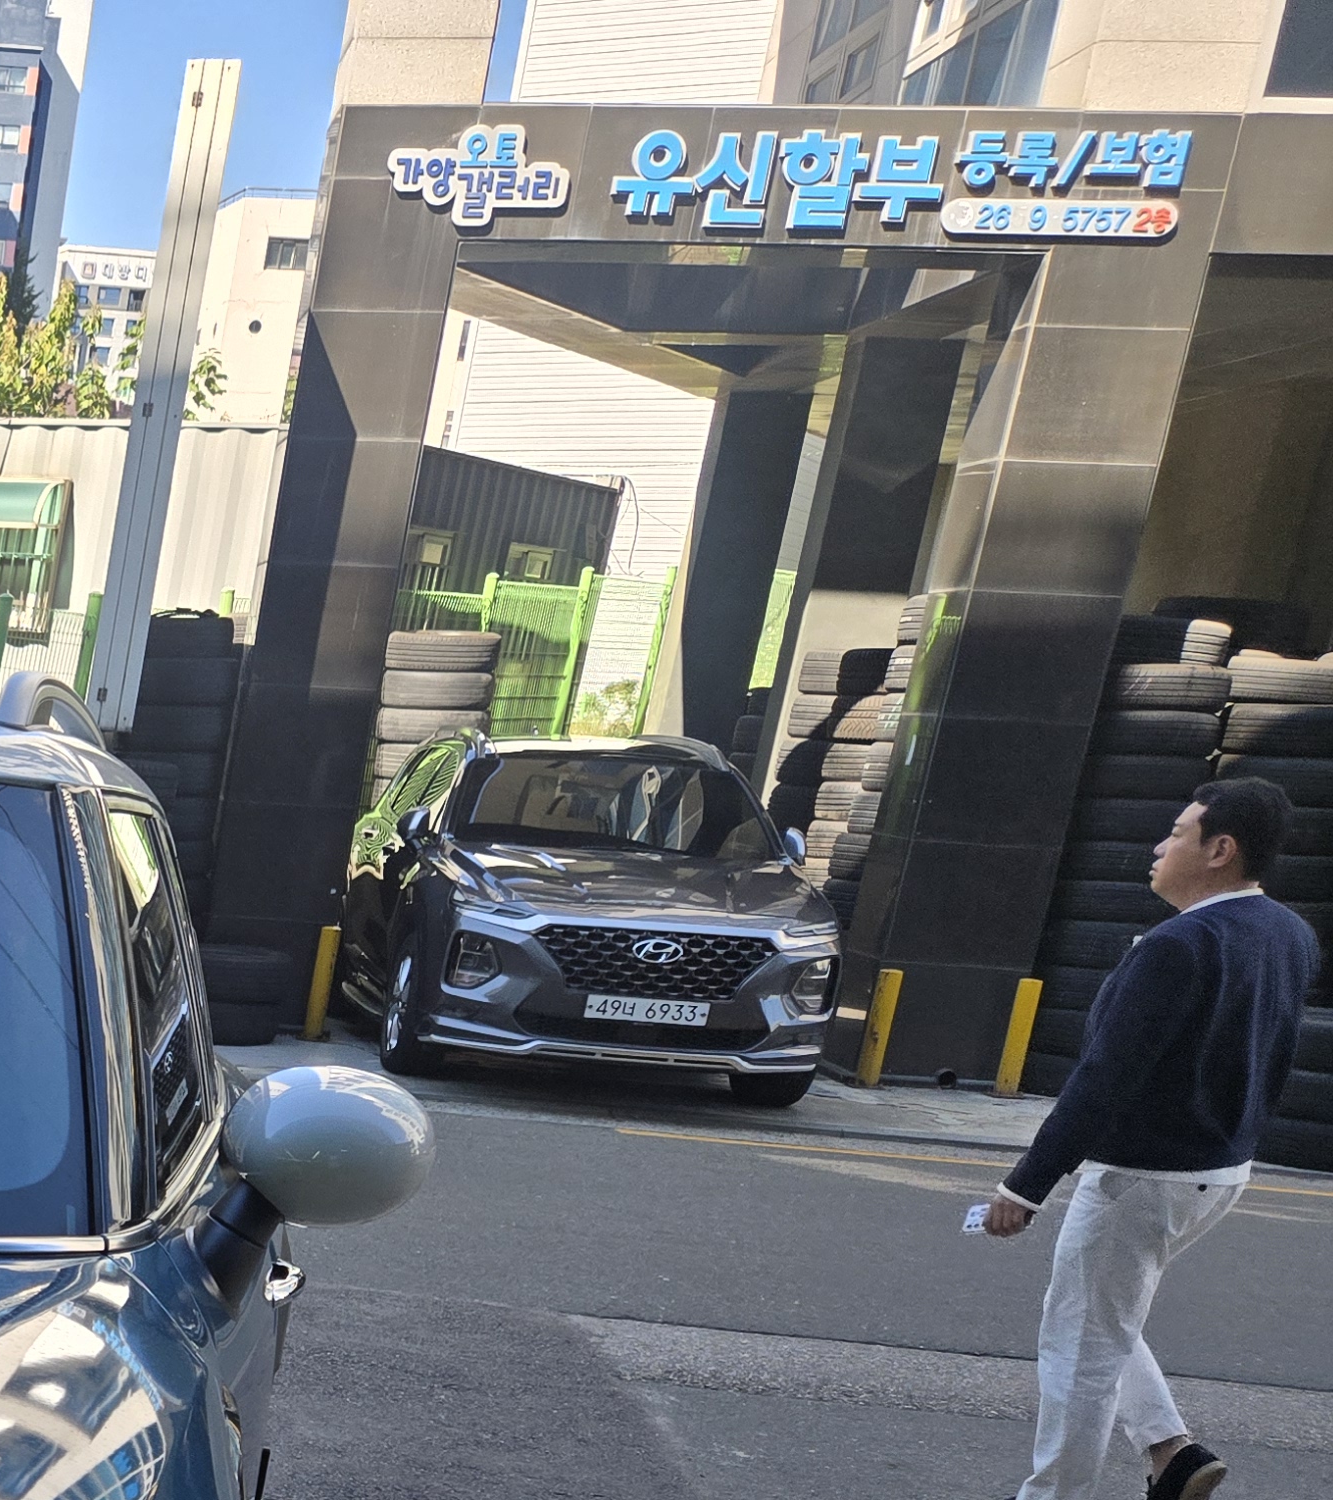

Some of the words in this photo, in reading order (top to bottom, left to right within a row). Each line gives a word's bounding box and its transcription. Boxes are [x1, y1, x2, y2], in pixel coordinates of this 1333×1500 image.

[460, 132, 518, 168] 오토
[954, 129, 1193, 190] 등록/보험
[396, 157, 457, 198] 가양
[457, 170, 561, 219] 갤러리
[610, 130, 944, 230] 유신할부
[1061, 206, 1132, 232] 5757
[1132, 207, 1173, 234] 2층
[644, 1002, 699, 1022] 6933
